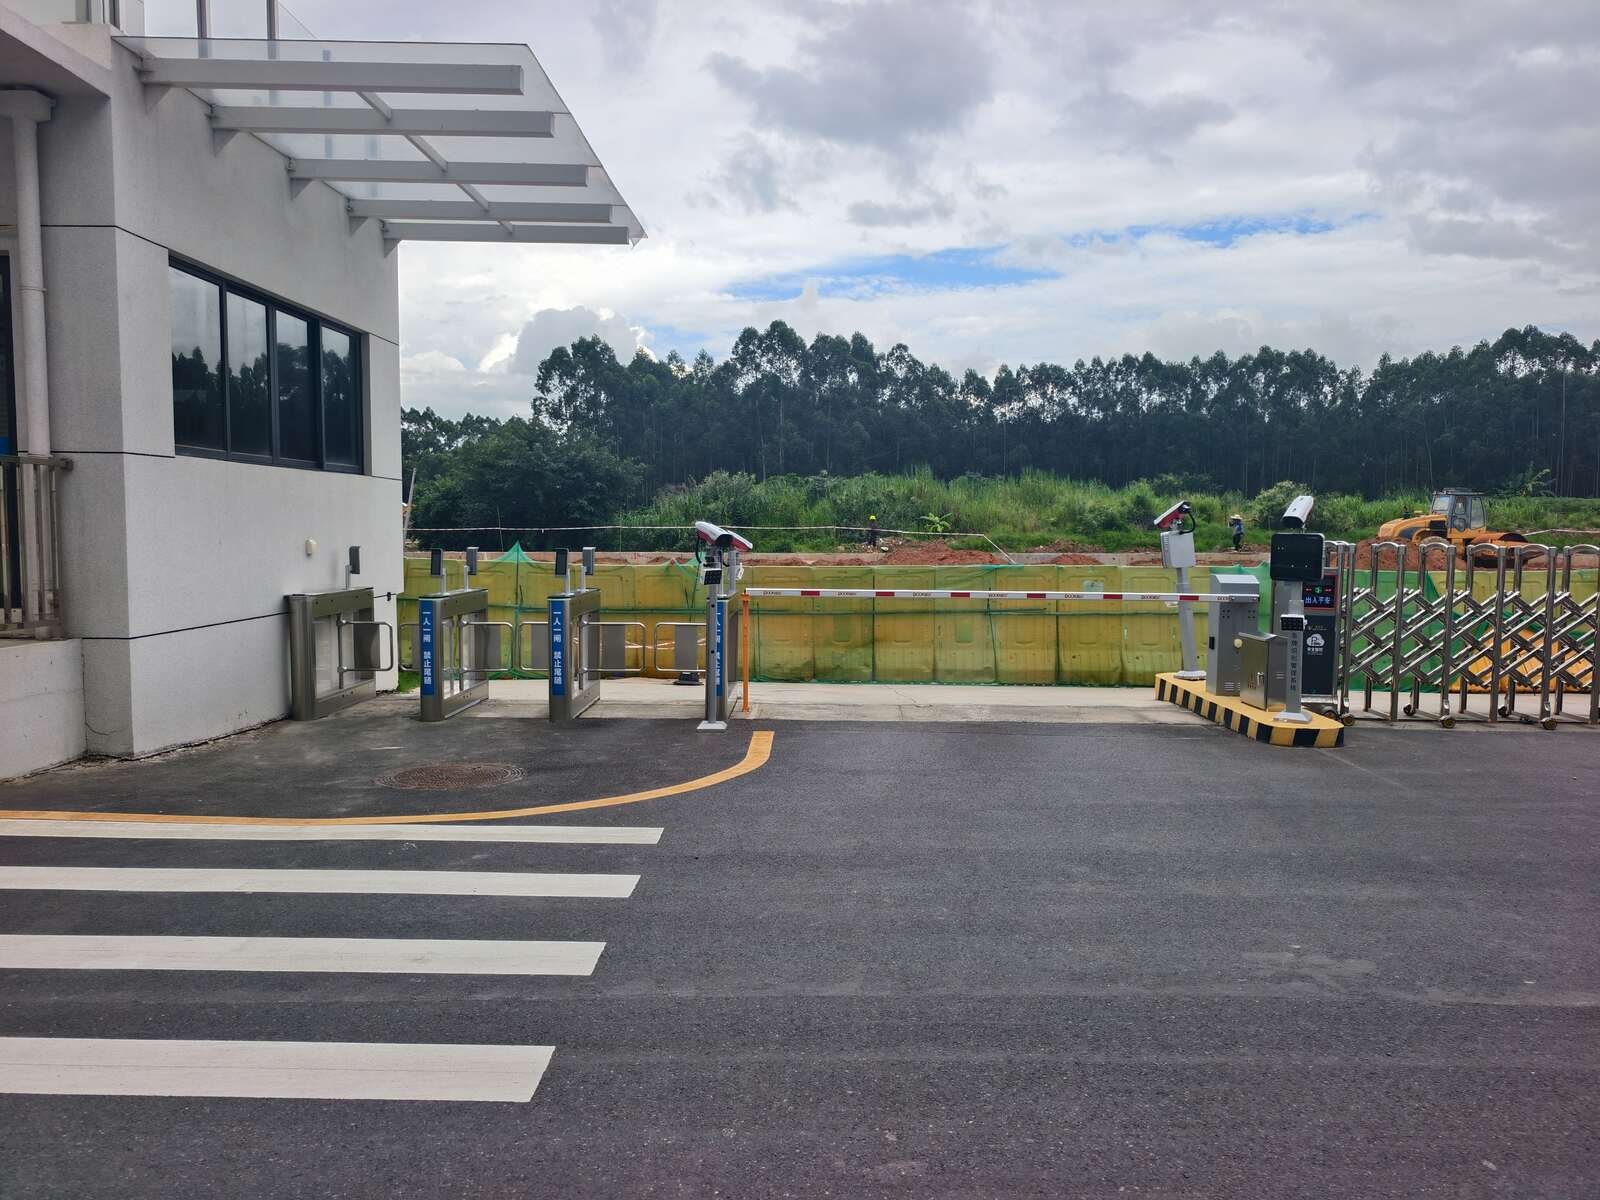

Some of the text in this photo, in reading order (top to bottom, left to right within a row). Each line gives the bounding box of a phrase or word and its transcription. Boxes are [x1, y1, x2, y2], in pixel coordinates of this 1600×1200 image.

[1305, 596, 1331, 604] 出入平安
[422, 611, 432, 685] 一人一闸 禁止尾随
[553, 611, 563, 685] 一人一闸 禁止尾随
